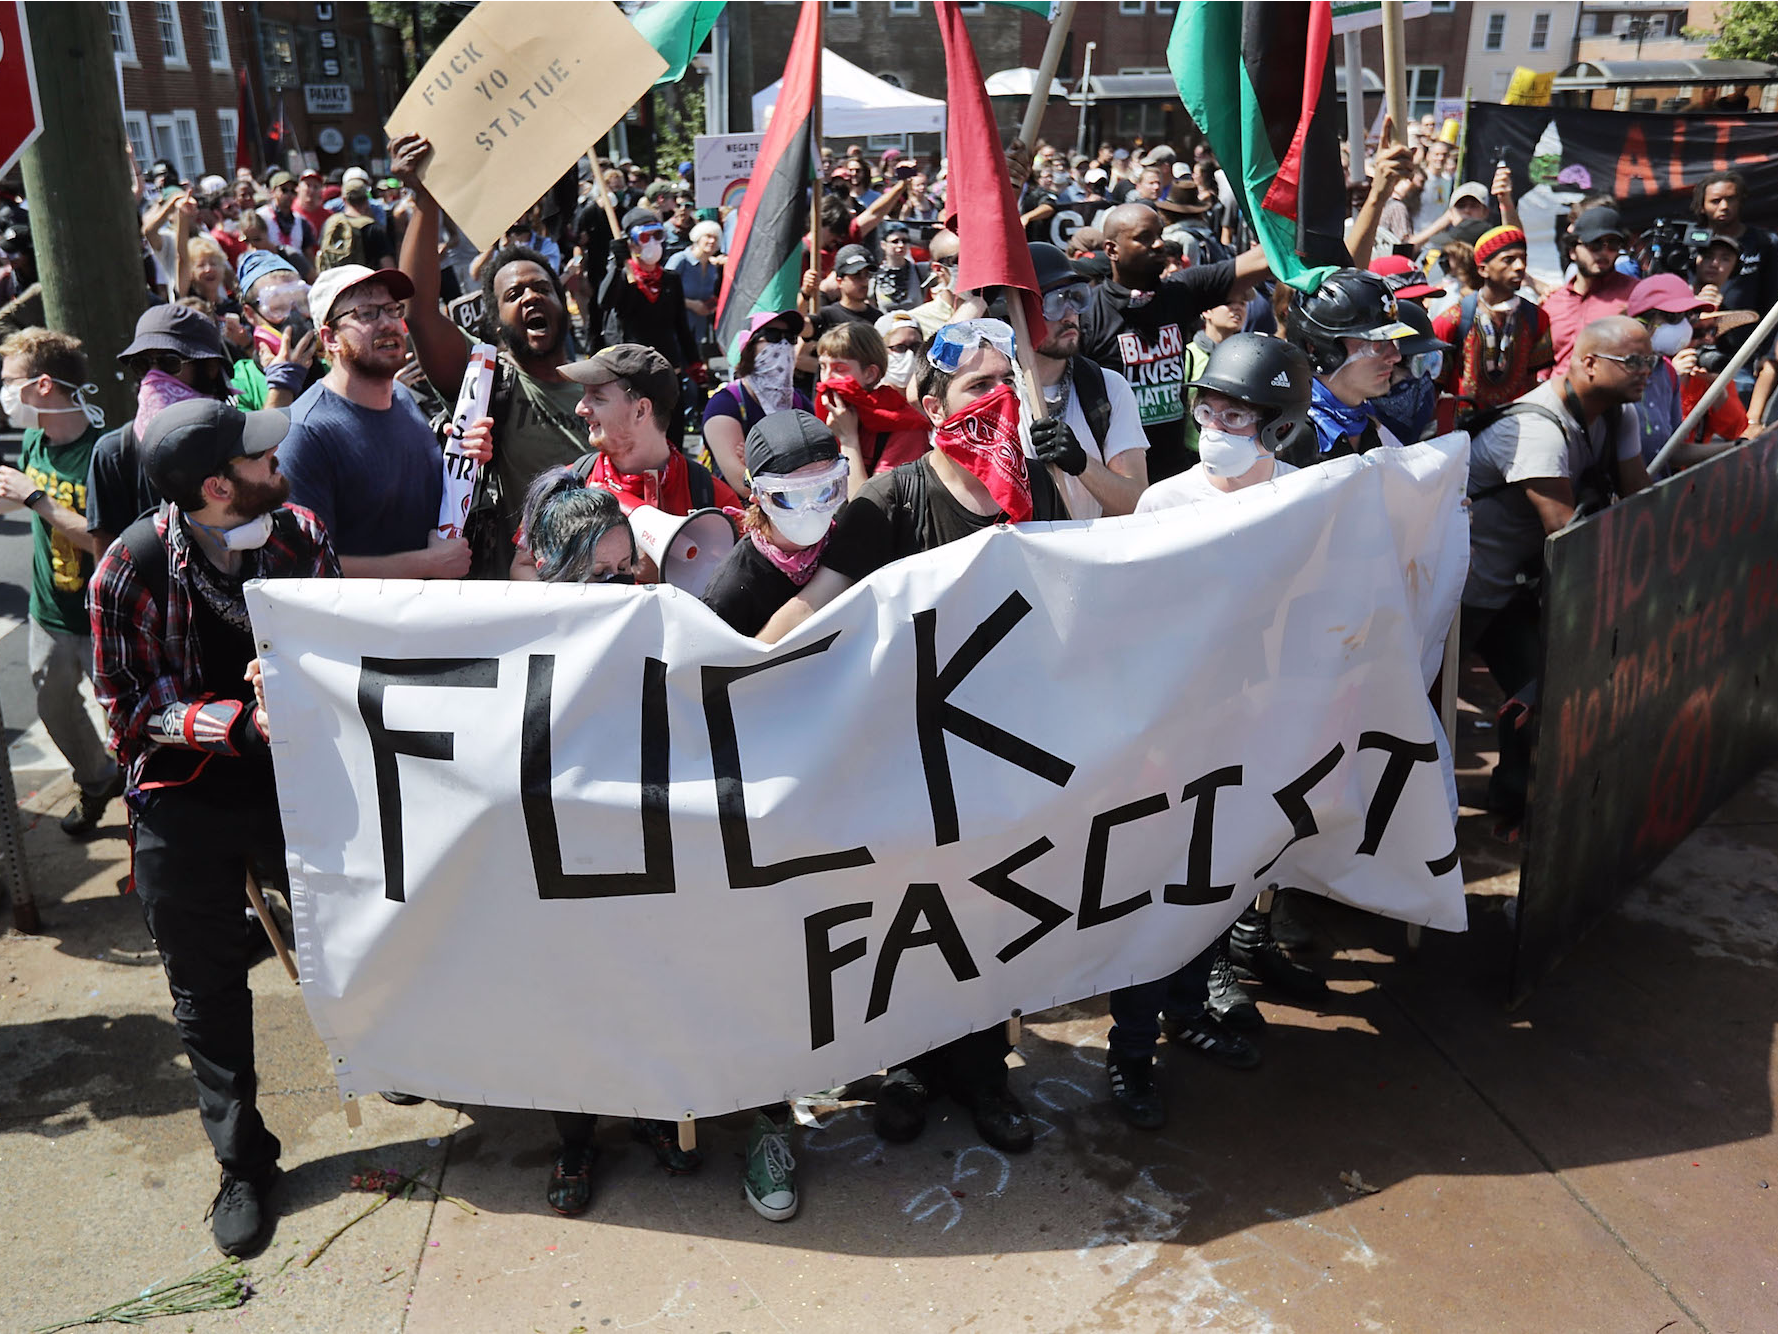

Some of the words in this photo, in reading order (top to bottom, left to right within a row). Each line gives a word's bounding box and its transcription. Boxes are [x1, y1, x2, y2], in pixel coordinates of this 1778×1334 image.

[422, 41, 484, 106] FUCK
[474, 69, 509, 101] YO
[475, 58, 580, 151] STATUE.
[1126, 355, 1184, 387] LIVES
[1140, 406, 1158, 418] EW
[1588, 504, 1656, 651] NO
[1667, 433, 1778, 577] GODS
[357, 589, 1076, 904] FUCK
[803, 730, 1459, 1051] FASCIST
